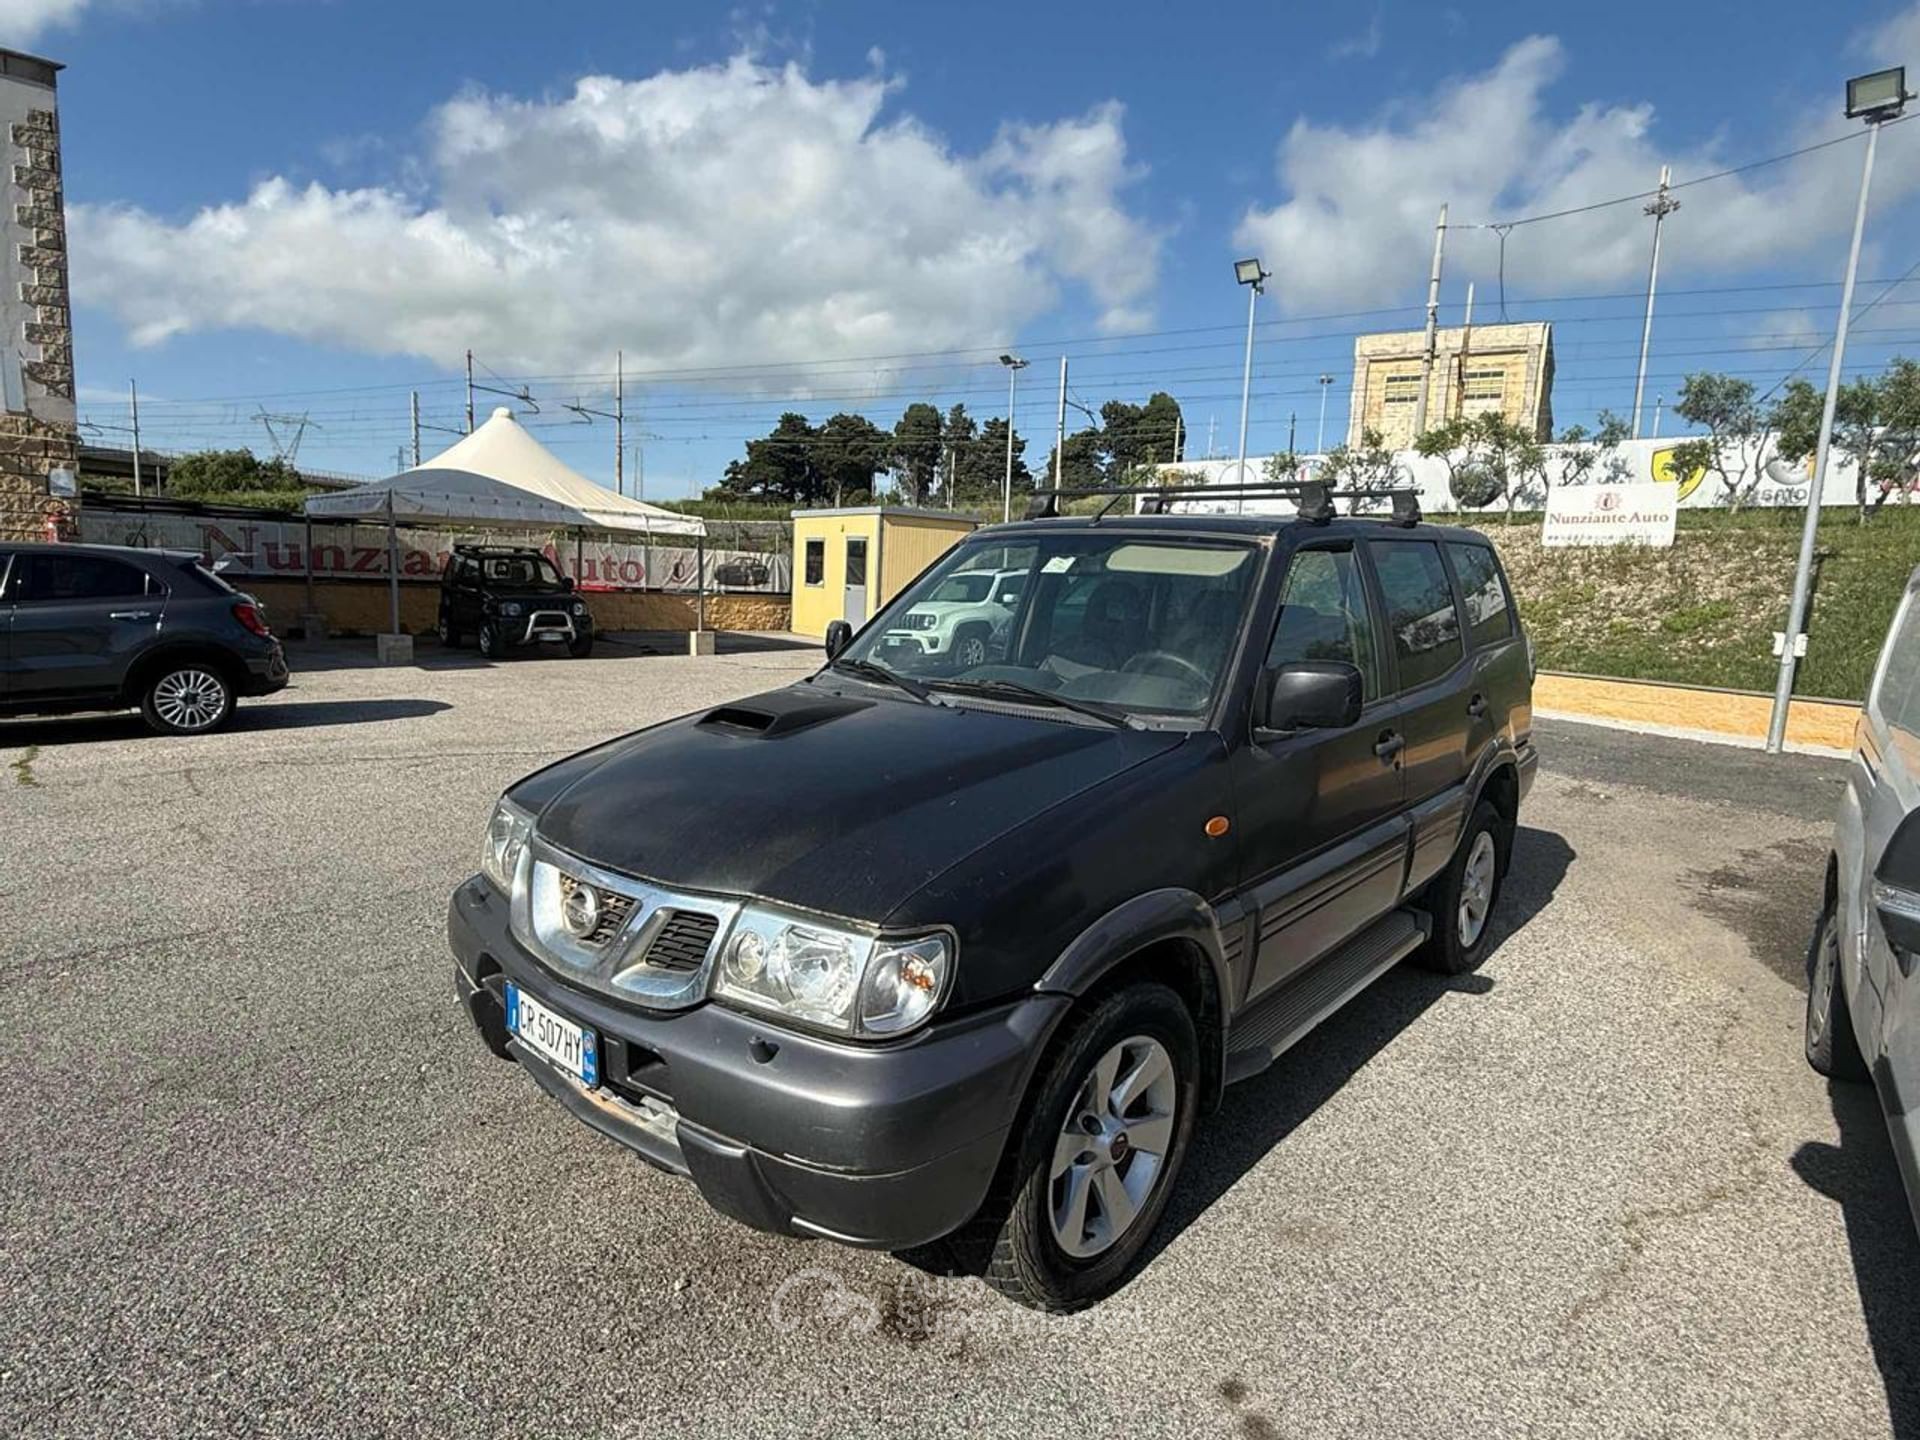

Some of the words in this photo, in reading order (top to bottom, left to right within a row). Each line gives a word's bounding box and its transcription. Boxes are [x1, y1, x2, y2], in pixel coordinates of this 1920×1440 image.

[1549, 512, 1627, 525] Nunziante
[1629, 511, 1670, 524] Auto
[196, 523, 451, 577] Nunzia
[520, 1000, 535, 1036] CR
[538, 1012, 581, 1066] 507HY
